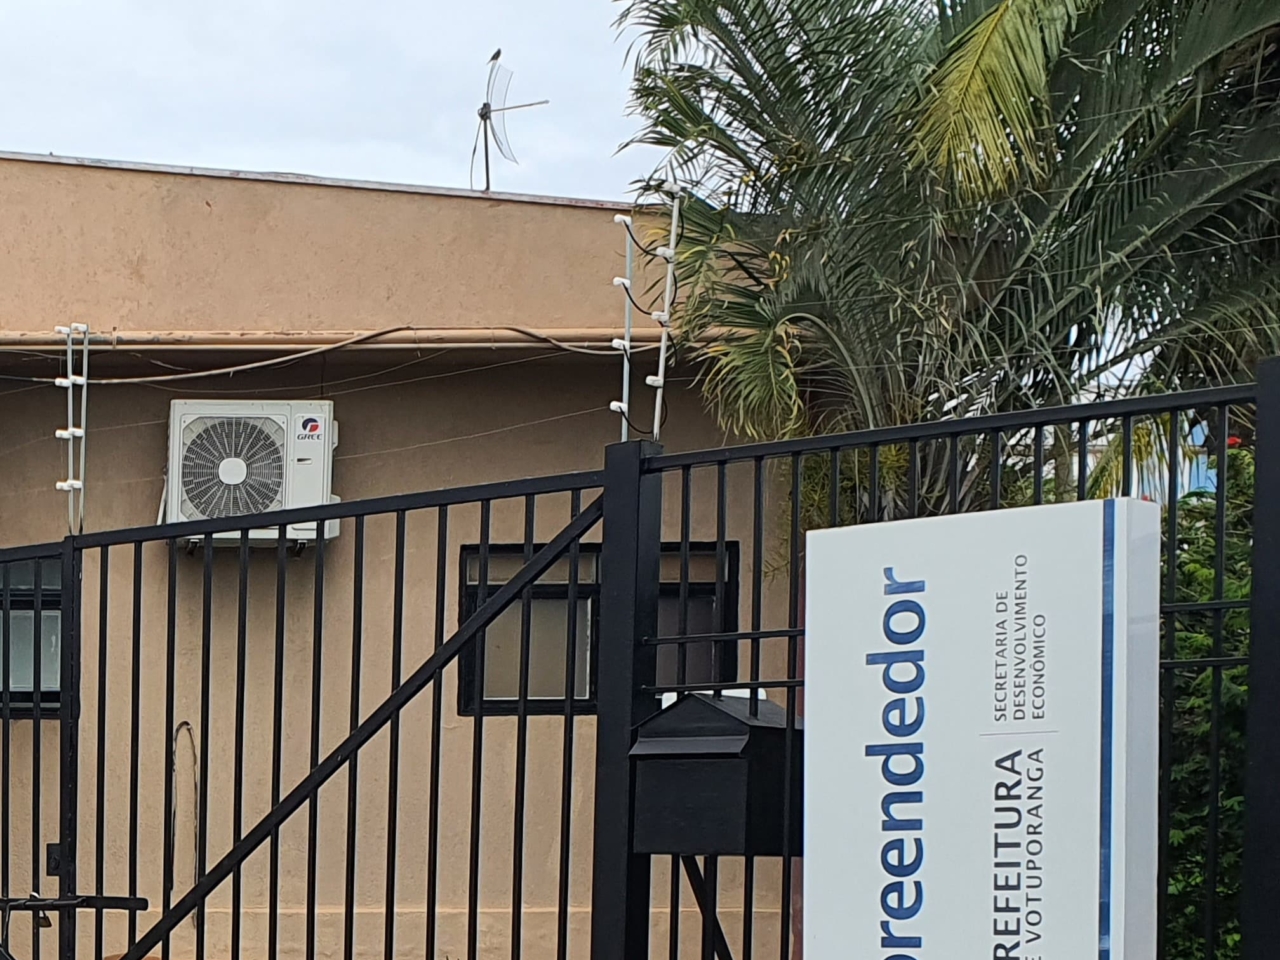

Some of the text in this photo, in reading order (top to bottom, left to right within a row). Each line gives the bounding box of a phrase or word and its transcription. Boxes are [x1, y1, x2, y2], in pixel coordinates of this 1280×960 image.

[993, 590, 1009, 722] SECRETARIA DE
[1012, 553, 1029, 721] DESENVOLVIMENTO
[1029, 613, 1046, 720] ECONÔMICO
[1024, 747, 1044, 945] VOTUPORANGA
